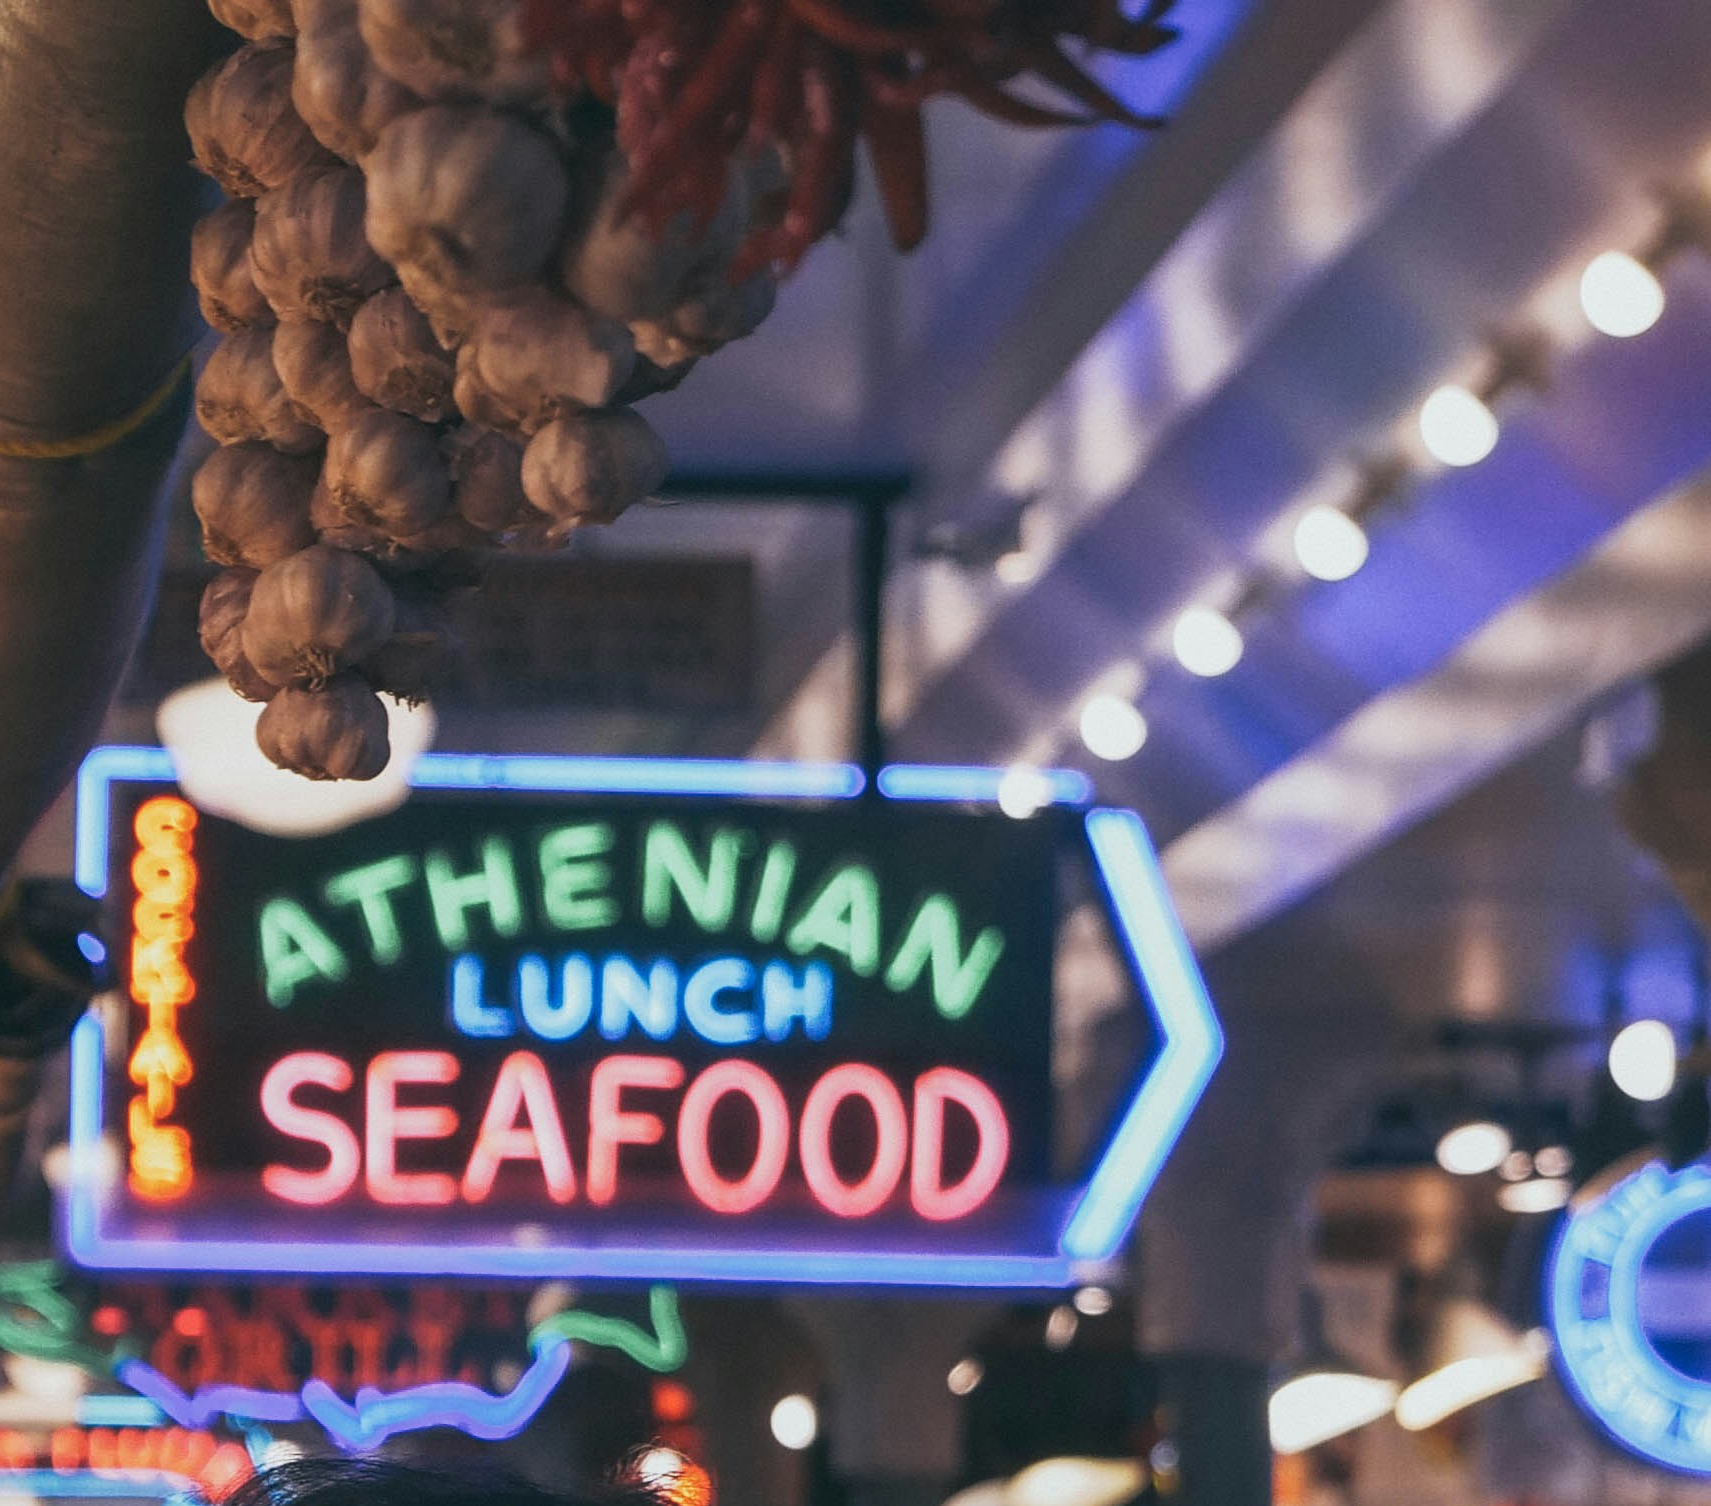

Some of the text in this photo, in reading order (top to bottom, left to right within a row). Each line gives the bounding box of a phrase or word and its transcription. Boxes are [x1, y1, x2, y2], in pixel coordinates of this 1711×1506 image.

[258, 820, 1006, 1021] ATHENIAN
[447, 950, 835, 1045] LUNCH
[259, 1048, 1011, 1222] SEAFOOD
